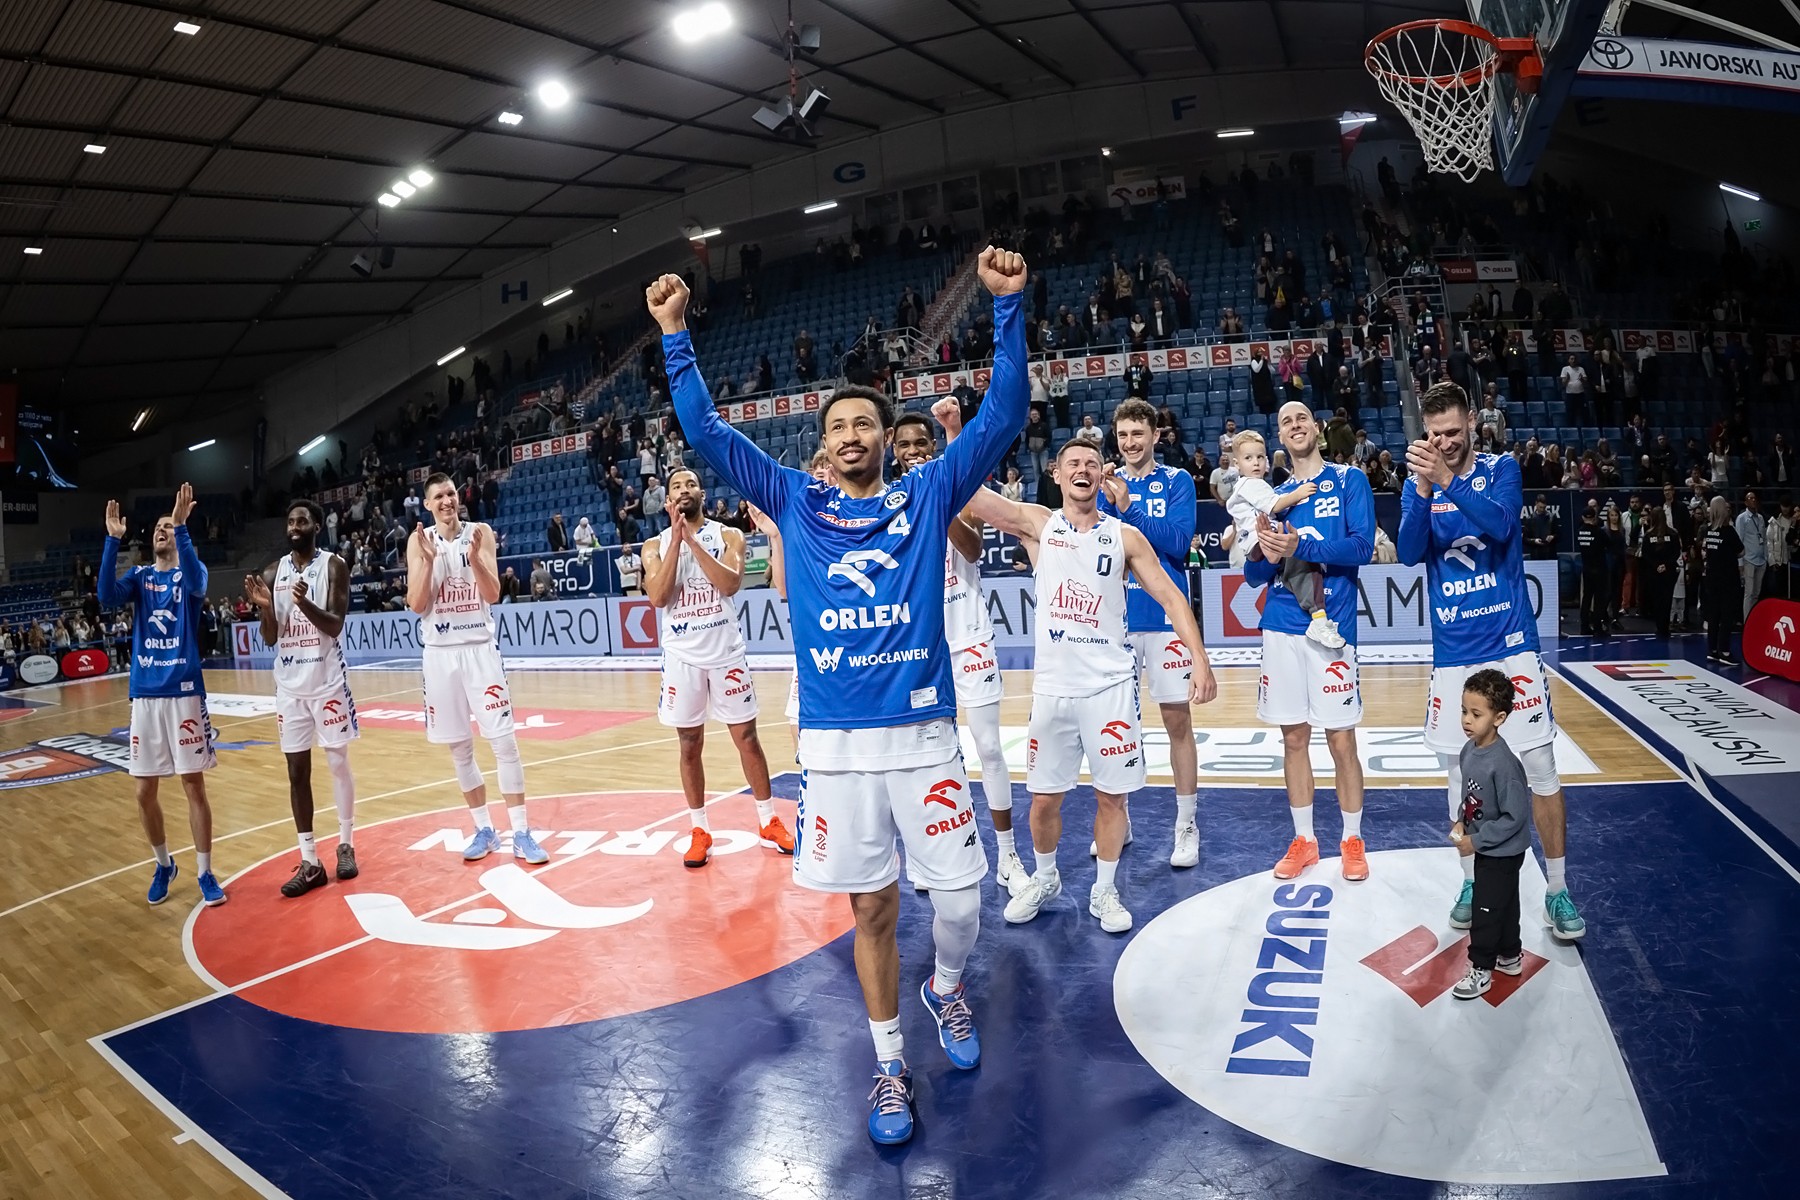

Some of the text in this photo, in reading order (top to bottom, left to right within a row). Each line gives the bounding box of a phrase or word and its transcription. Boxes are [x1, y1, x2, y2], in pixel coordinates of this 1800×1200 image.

[1660, 50, 1764, 77] JAWORSKI
[1171, 95, 1197, 121] F
[833, 162, 866, 184] G
[1136, 183, 1183, 197] ORN
[501, 281, 528, 304] H
[3, 502, 37, 512] ER-BRUK
[1146, 498, 1166, 518] 13
[1314, 496, 1340, 518] 22
[887, 510, 910, 537] 4
[711, 548, 719, 559] 7
[1097, 554, 1112, 576] 0
[434, 581, 477, 605] Anwil
[1441, 572, 1497, 597] ORLEN
[173, 586, 182, 602] 8
[1050, 582, 1103, 615] Anwil
[456, 604, 479, 612] ORLEN
[673, 605, 722, 620] GRUPA ORLEN
[1050, 612, 1074, 621] GRUPA
[1461, 601, 1511, 619] WŁOCŁAWEK
[691, 618, 729, 632] WŁOCŁAWEK
[819, 602, 911, 632] ORLEN
[498, 608, 599, 646] AMARO
[145, 637, 180, 649] ORLEN
[1067, 636, 1109, 645] WŁOCŁAWEK
[848, 647, 929, 668] WŁOCŁAWEK
[1764, 645, 1793, 663] ORLEN
[963, 659, 995, 673] ORLEN
[1162, 658, 1192, 670] ORLEN
[725, 683, 751, 696] ORLEN
[1323, 682, 1354, 694] ORLEN
[485, 699, 509, 711] ORLEN
[1512, 695, 1542, 712] RLEN
[1675, 683, 1776, 720] POWIAT
[323, 714, 348, 726] ORLEN
[1528, 711, 1544, 724] 4F
[1627, 683, 1786, 766] WŁOCŁAWSKI
[179, 736, 204, 746] ORLEN
[1100, 741, 1137, 757] ORLEN
[1124, 757, 1139, 768] 4F
[925, 807, 973, 837] ORLEN
[964, 830, 977, 848] 4F
[1225, 883, 1334, 1077] SUZUKI
